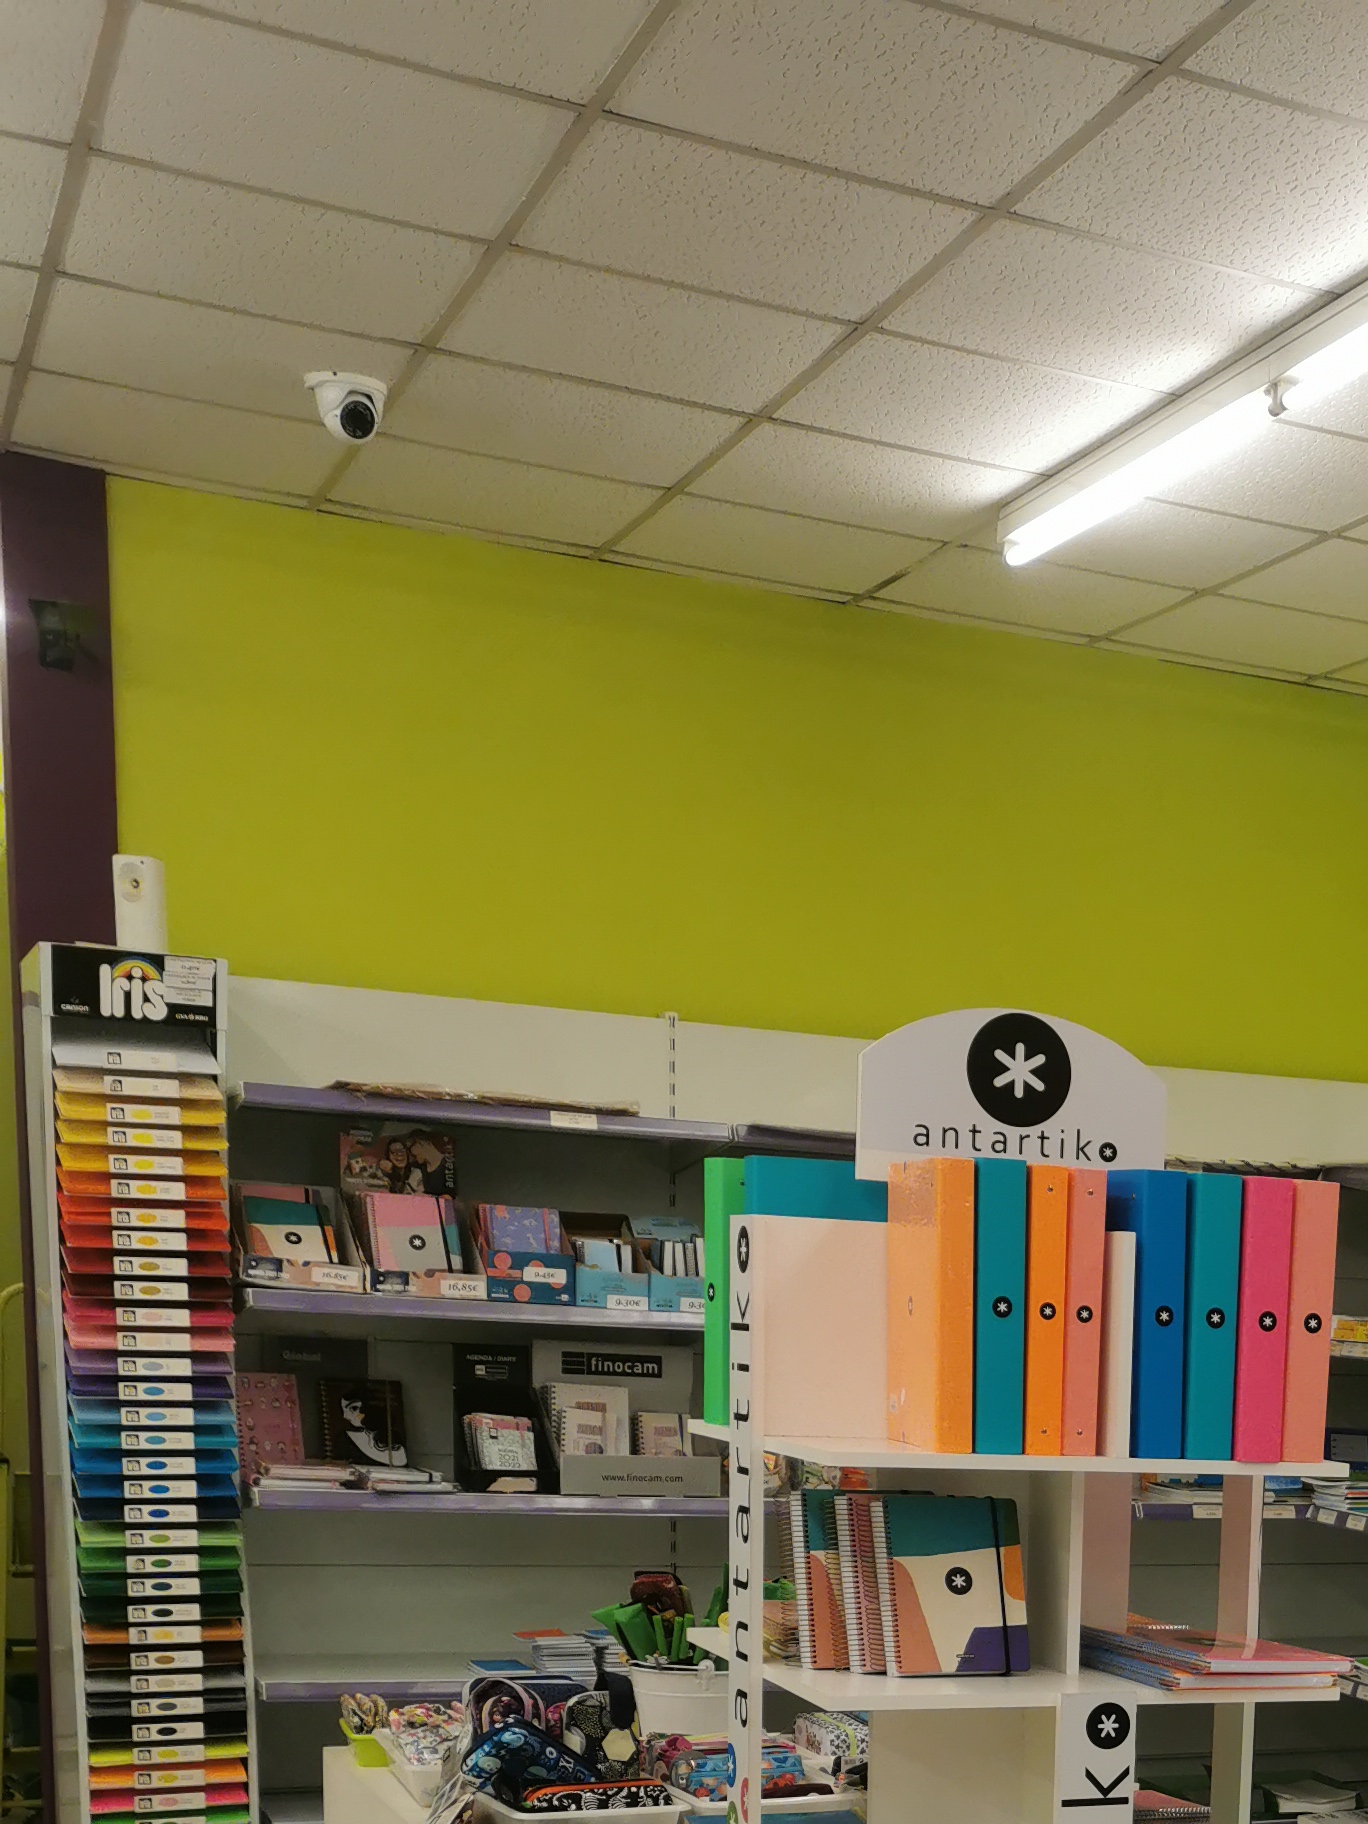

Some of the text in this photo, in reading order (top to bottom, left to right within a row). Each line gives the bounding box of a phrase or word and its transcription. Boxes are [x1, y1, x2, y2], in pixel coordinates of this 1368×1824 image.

[99, 963, 168, 1021] Iris
[590, 1356, 658, 1375] finocam
[601, 1473, 684, 1483] www.finocam.com
